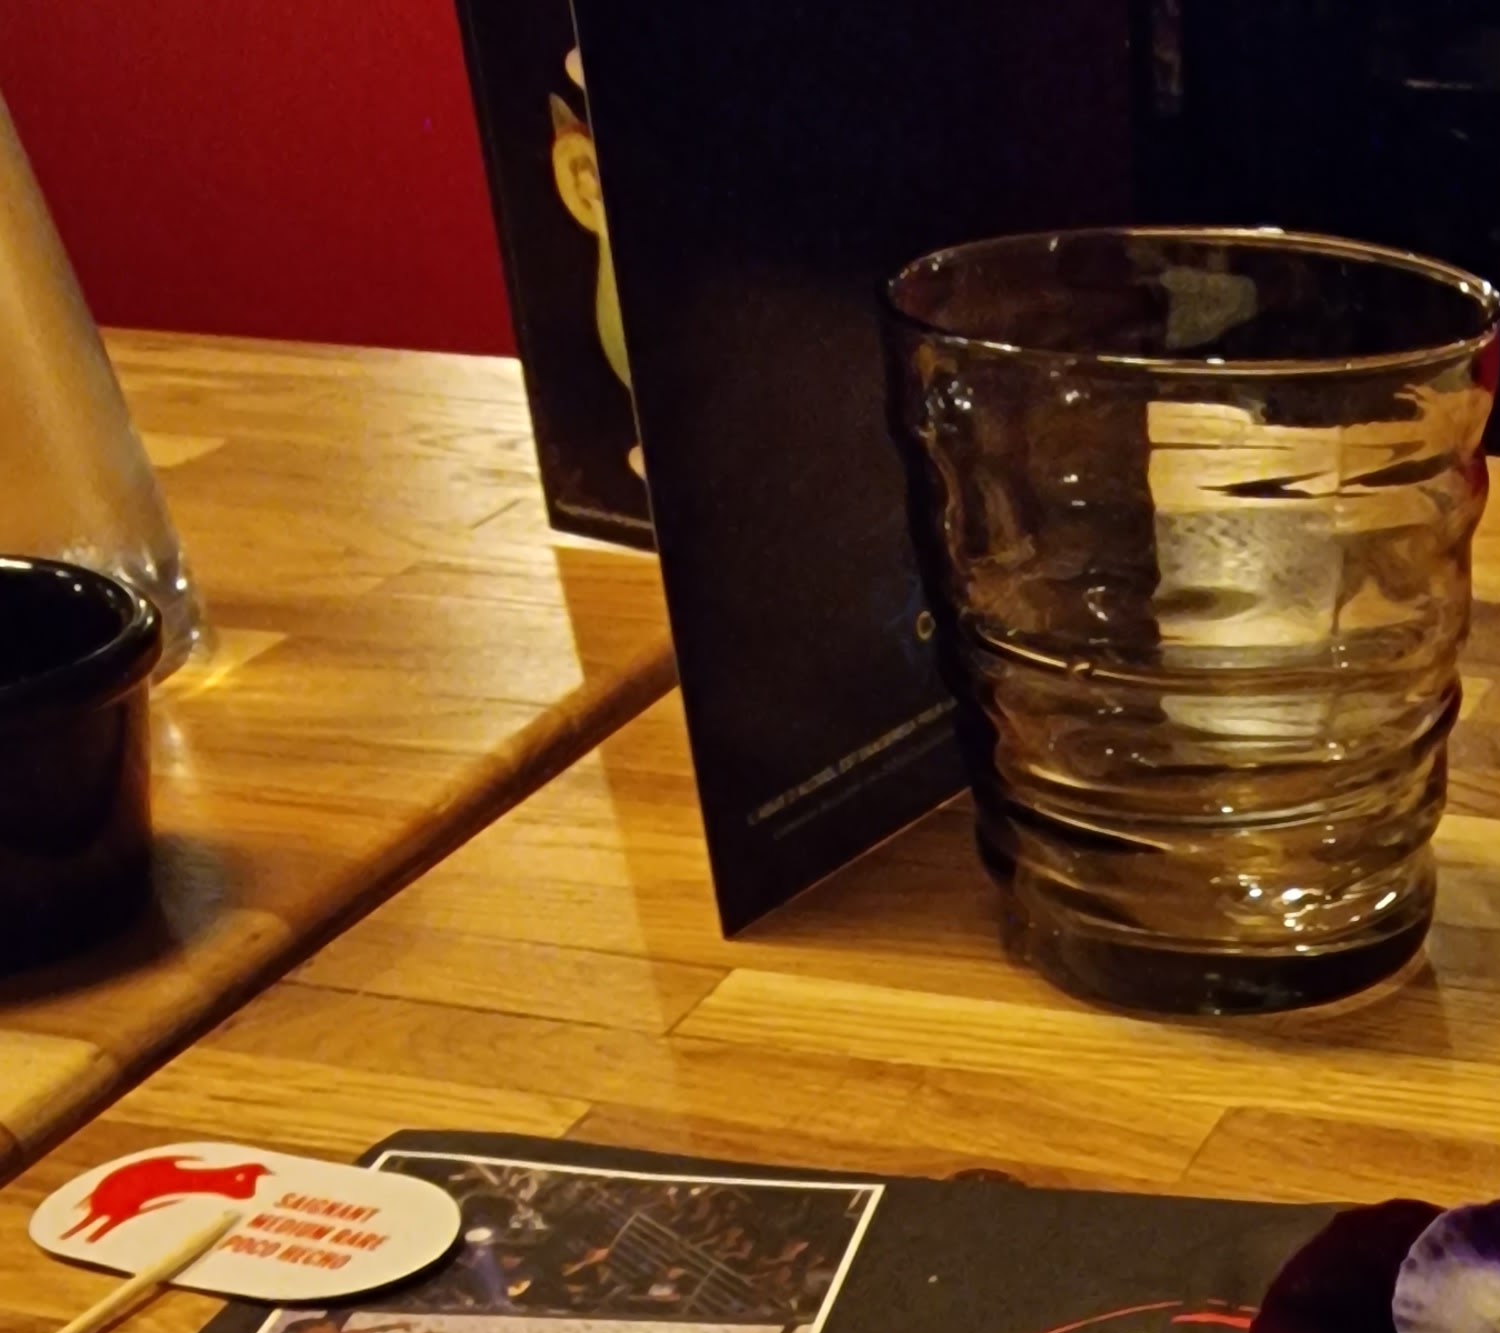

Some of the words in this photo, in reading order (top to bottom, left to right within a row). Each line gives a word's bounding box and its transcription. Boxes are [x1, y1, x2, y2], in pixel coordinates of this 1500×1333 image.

[273, 1192, 381, 1223] SAIGNANT
[247, 1213, 336, 1240] MEDIUM
[328, 1228, 391, 1251] RARE
[218, 1234, 282, 1258] POCO
[277, 1244, 353, 1270] HECHO
